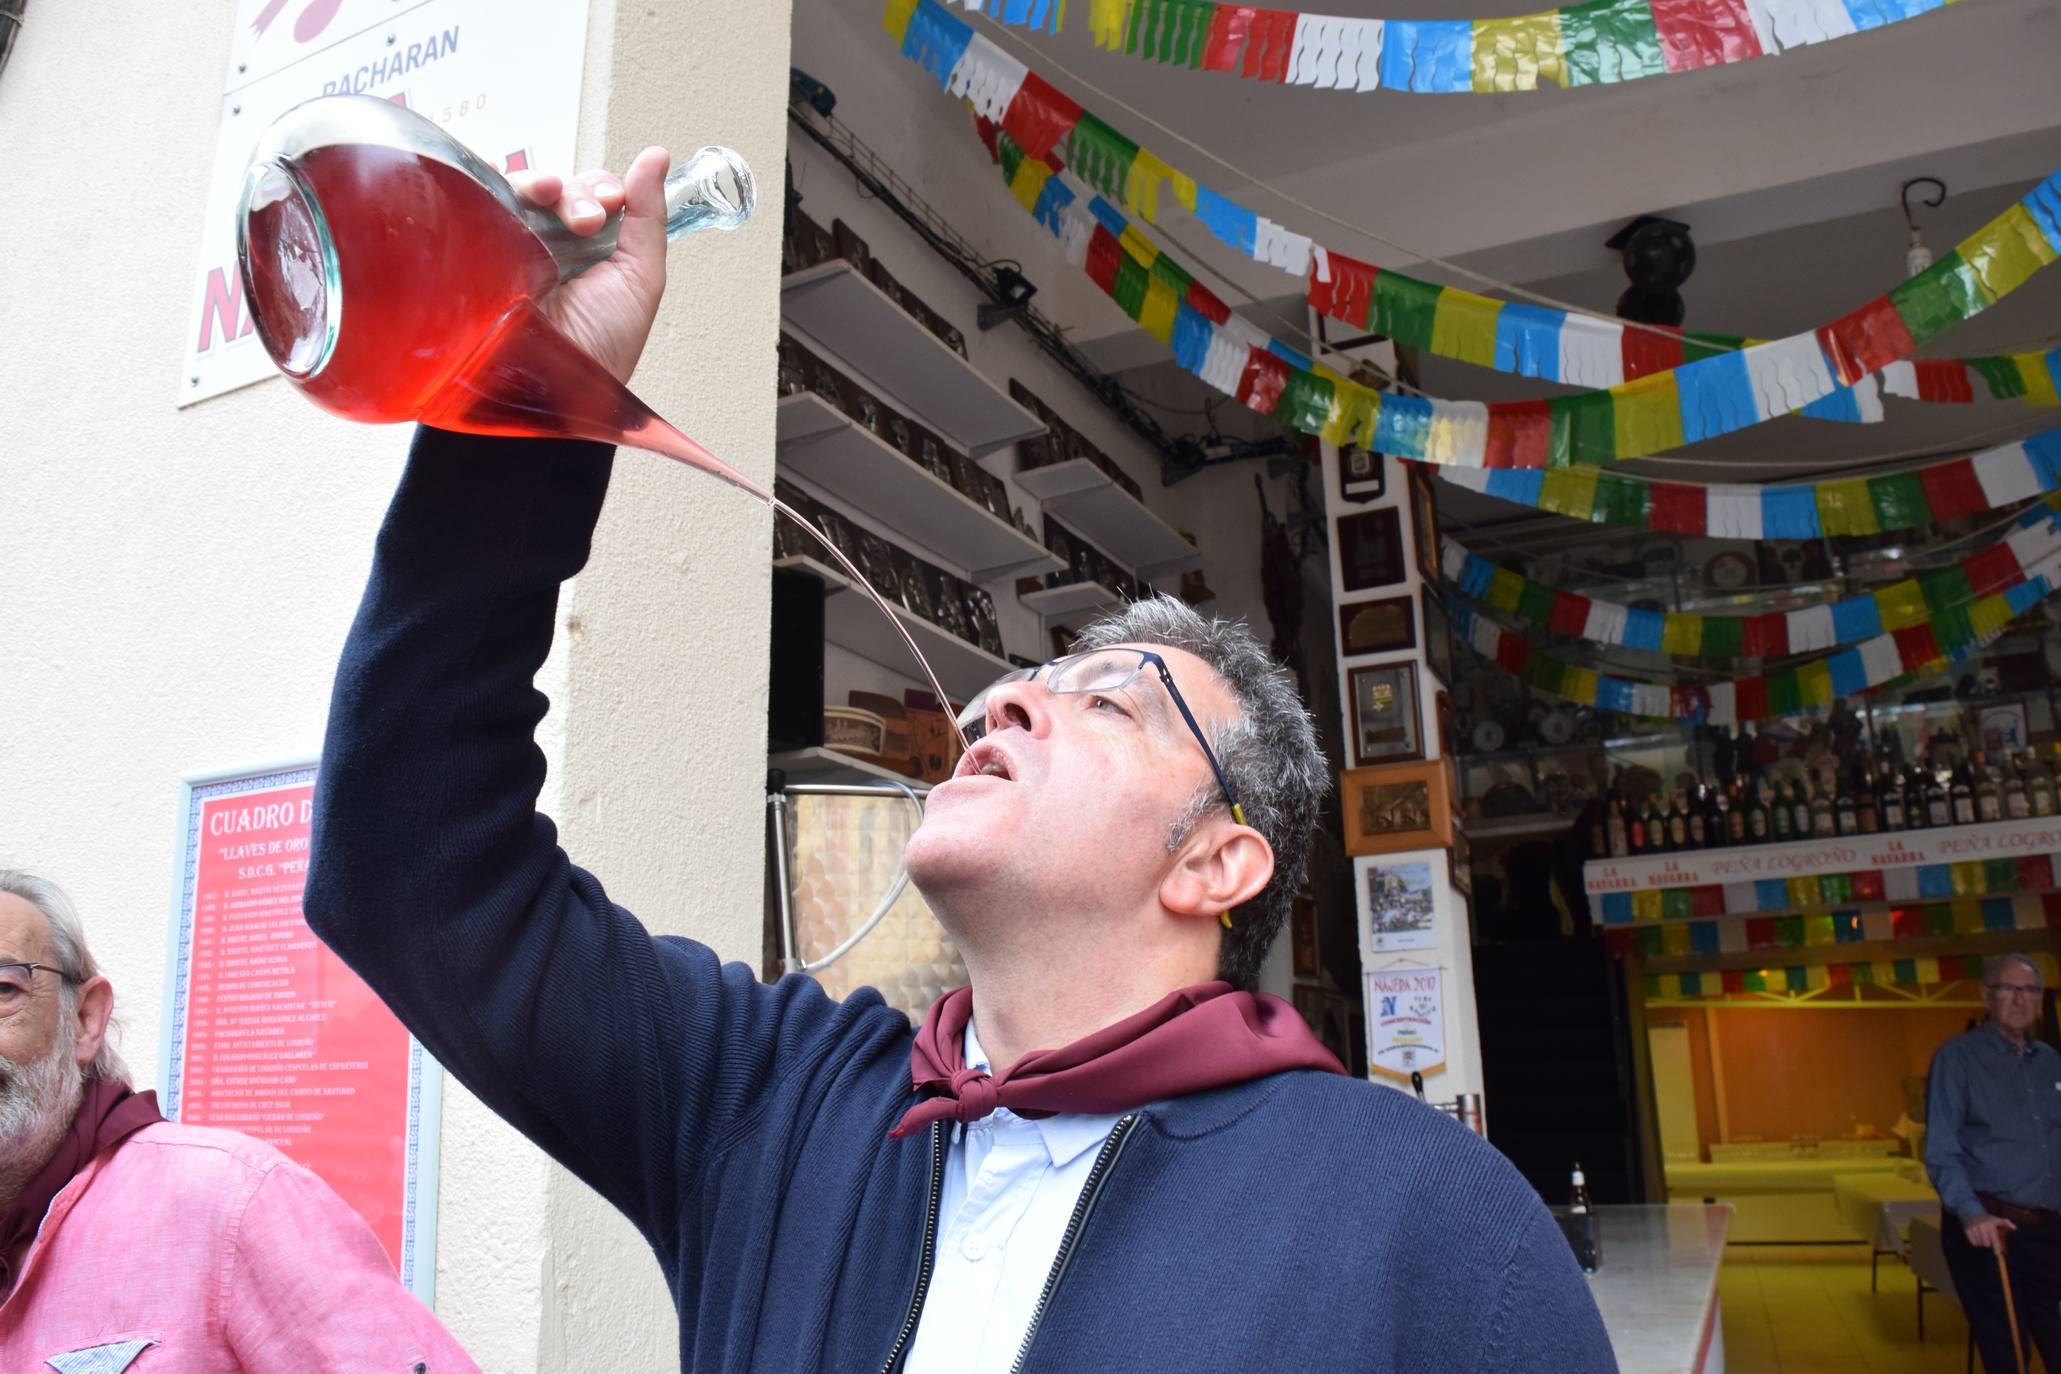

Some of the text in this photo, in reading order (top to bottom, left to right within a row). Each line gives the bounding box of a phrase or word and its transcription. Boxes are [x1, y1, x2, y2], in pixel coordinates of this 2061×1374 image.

[429, 93, 487, 123] 580
[210, 801, 294, 836] CUADRO
[268, 840, 283, 855] DE
[285, 837, 309, 852] ORO
[1887, 840, 1904, 852] LA
